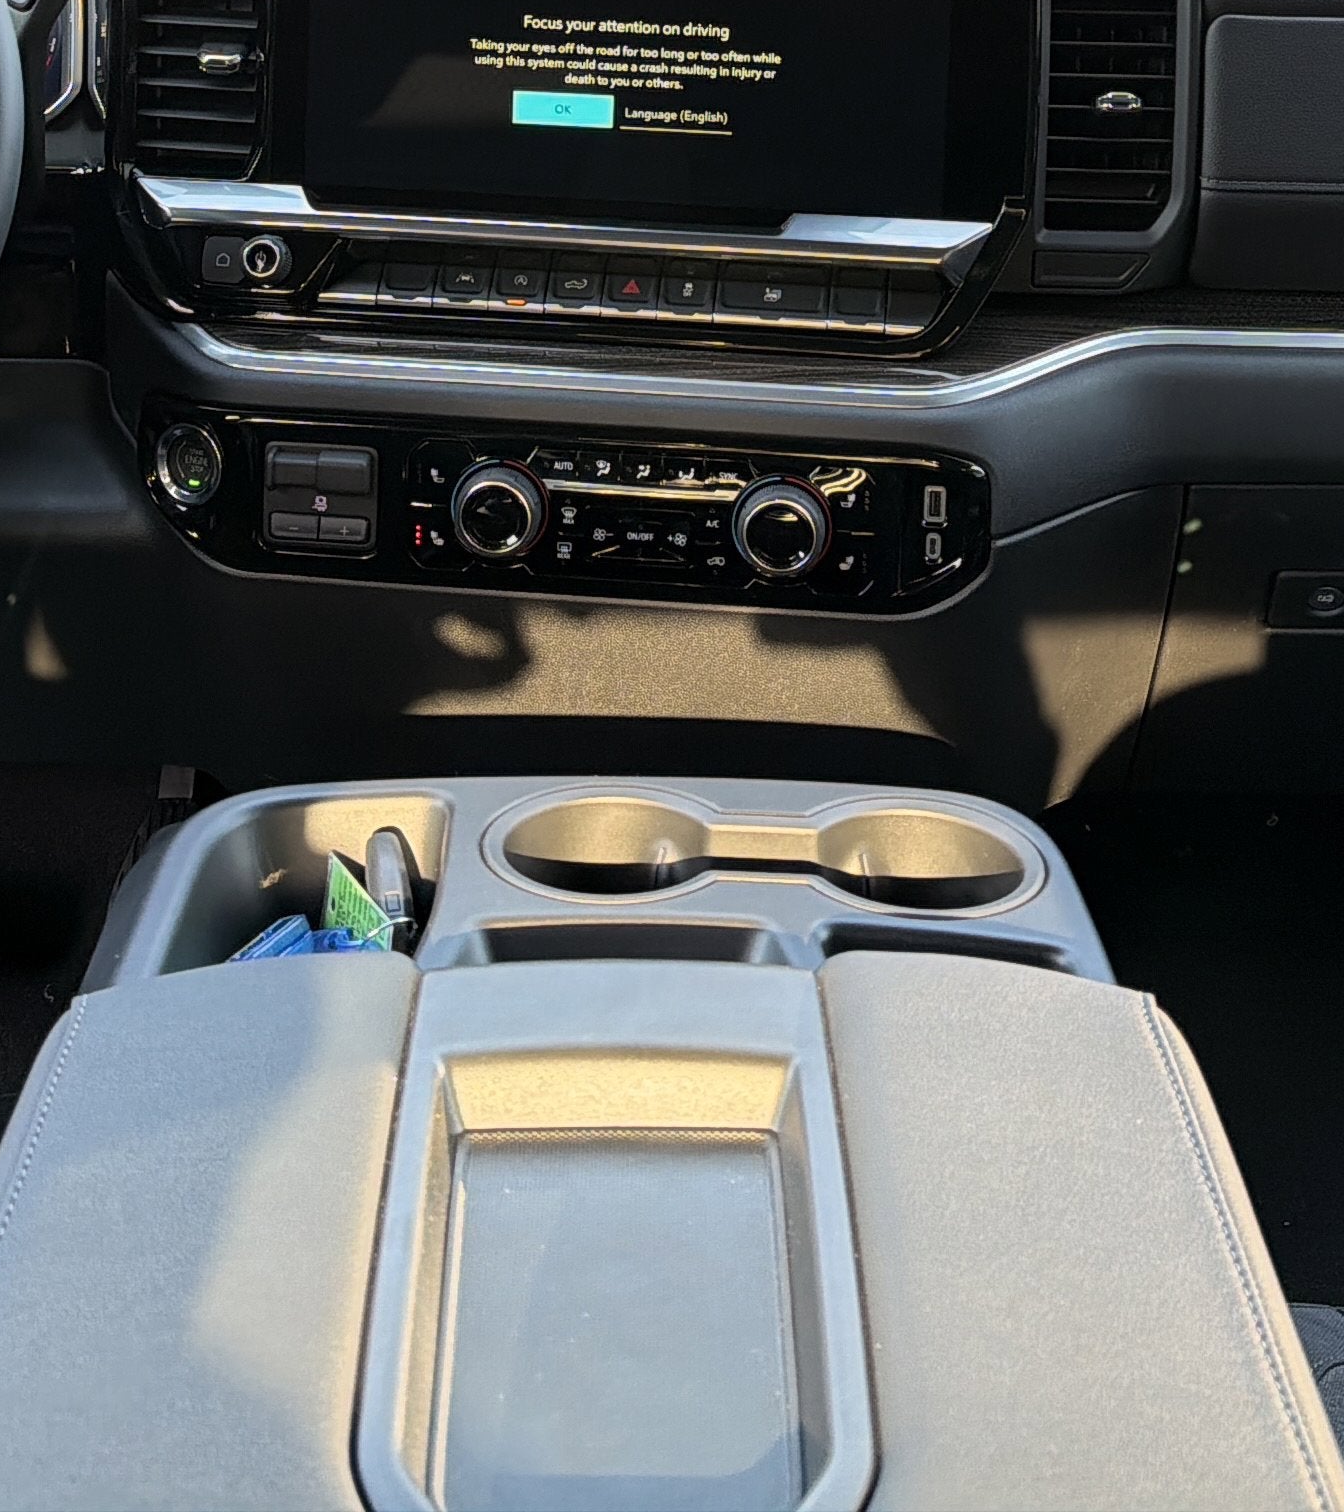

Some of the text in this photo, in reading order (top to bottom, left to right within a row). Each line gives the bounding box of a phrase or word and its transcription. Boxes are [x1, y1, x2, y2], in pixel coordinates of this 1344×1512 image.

[523, 15, 730, 41] Focus your attention on driving
[470, 39, 782, 64] Taking your eyes off the road for too long or too often while
[475, 54, 776, 81] using this system could cause a crash resulting in injury or
[565, 73, 683, 90] death to you or others.
[554, 104, 572, 114] OK
[625, 107, 728, 125] Language (English)
[554, 461, 574, 471] AUTO
[706, 520, 720, 529] A/C
[627, 533, 654, 541] ON/OFF
